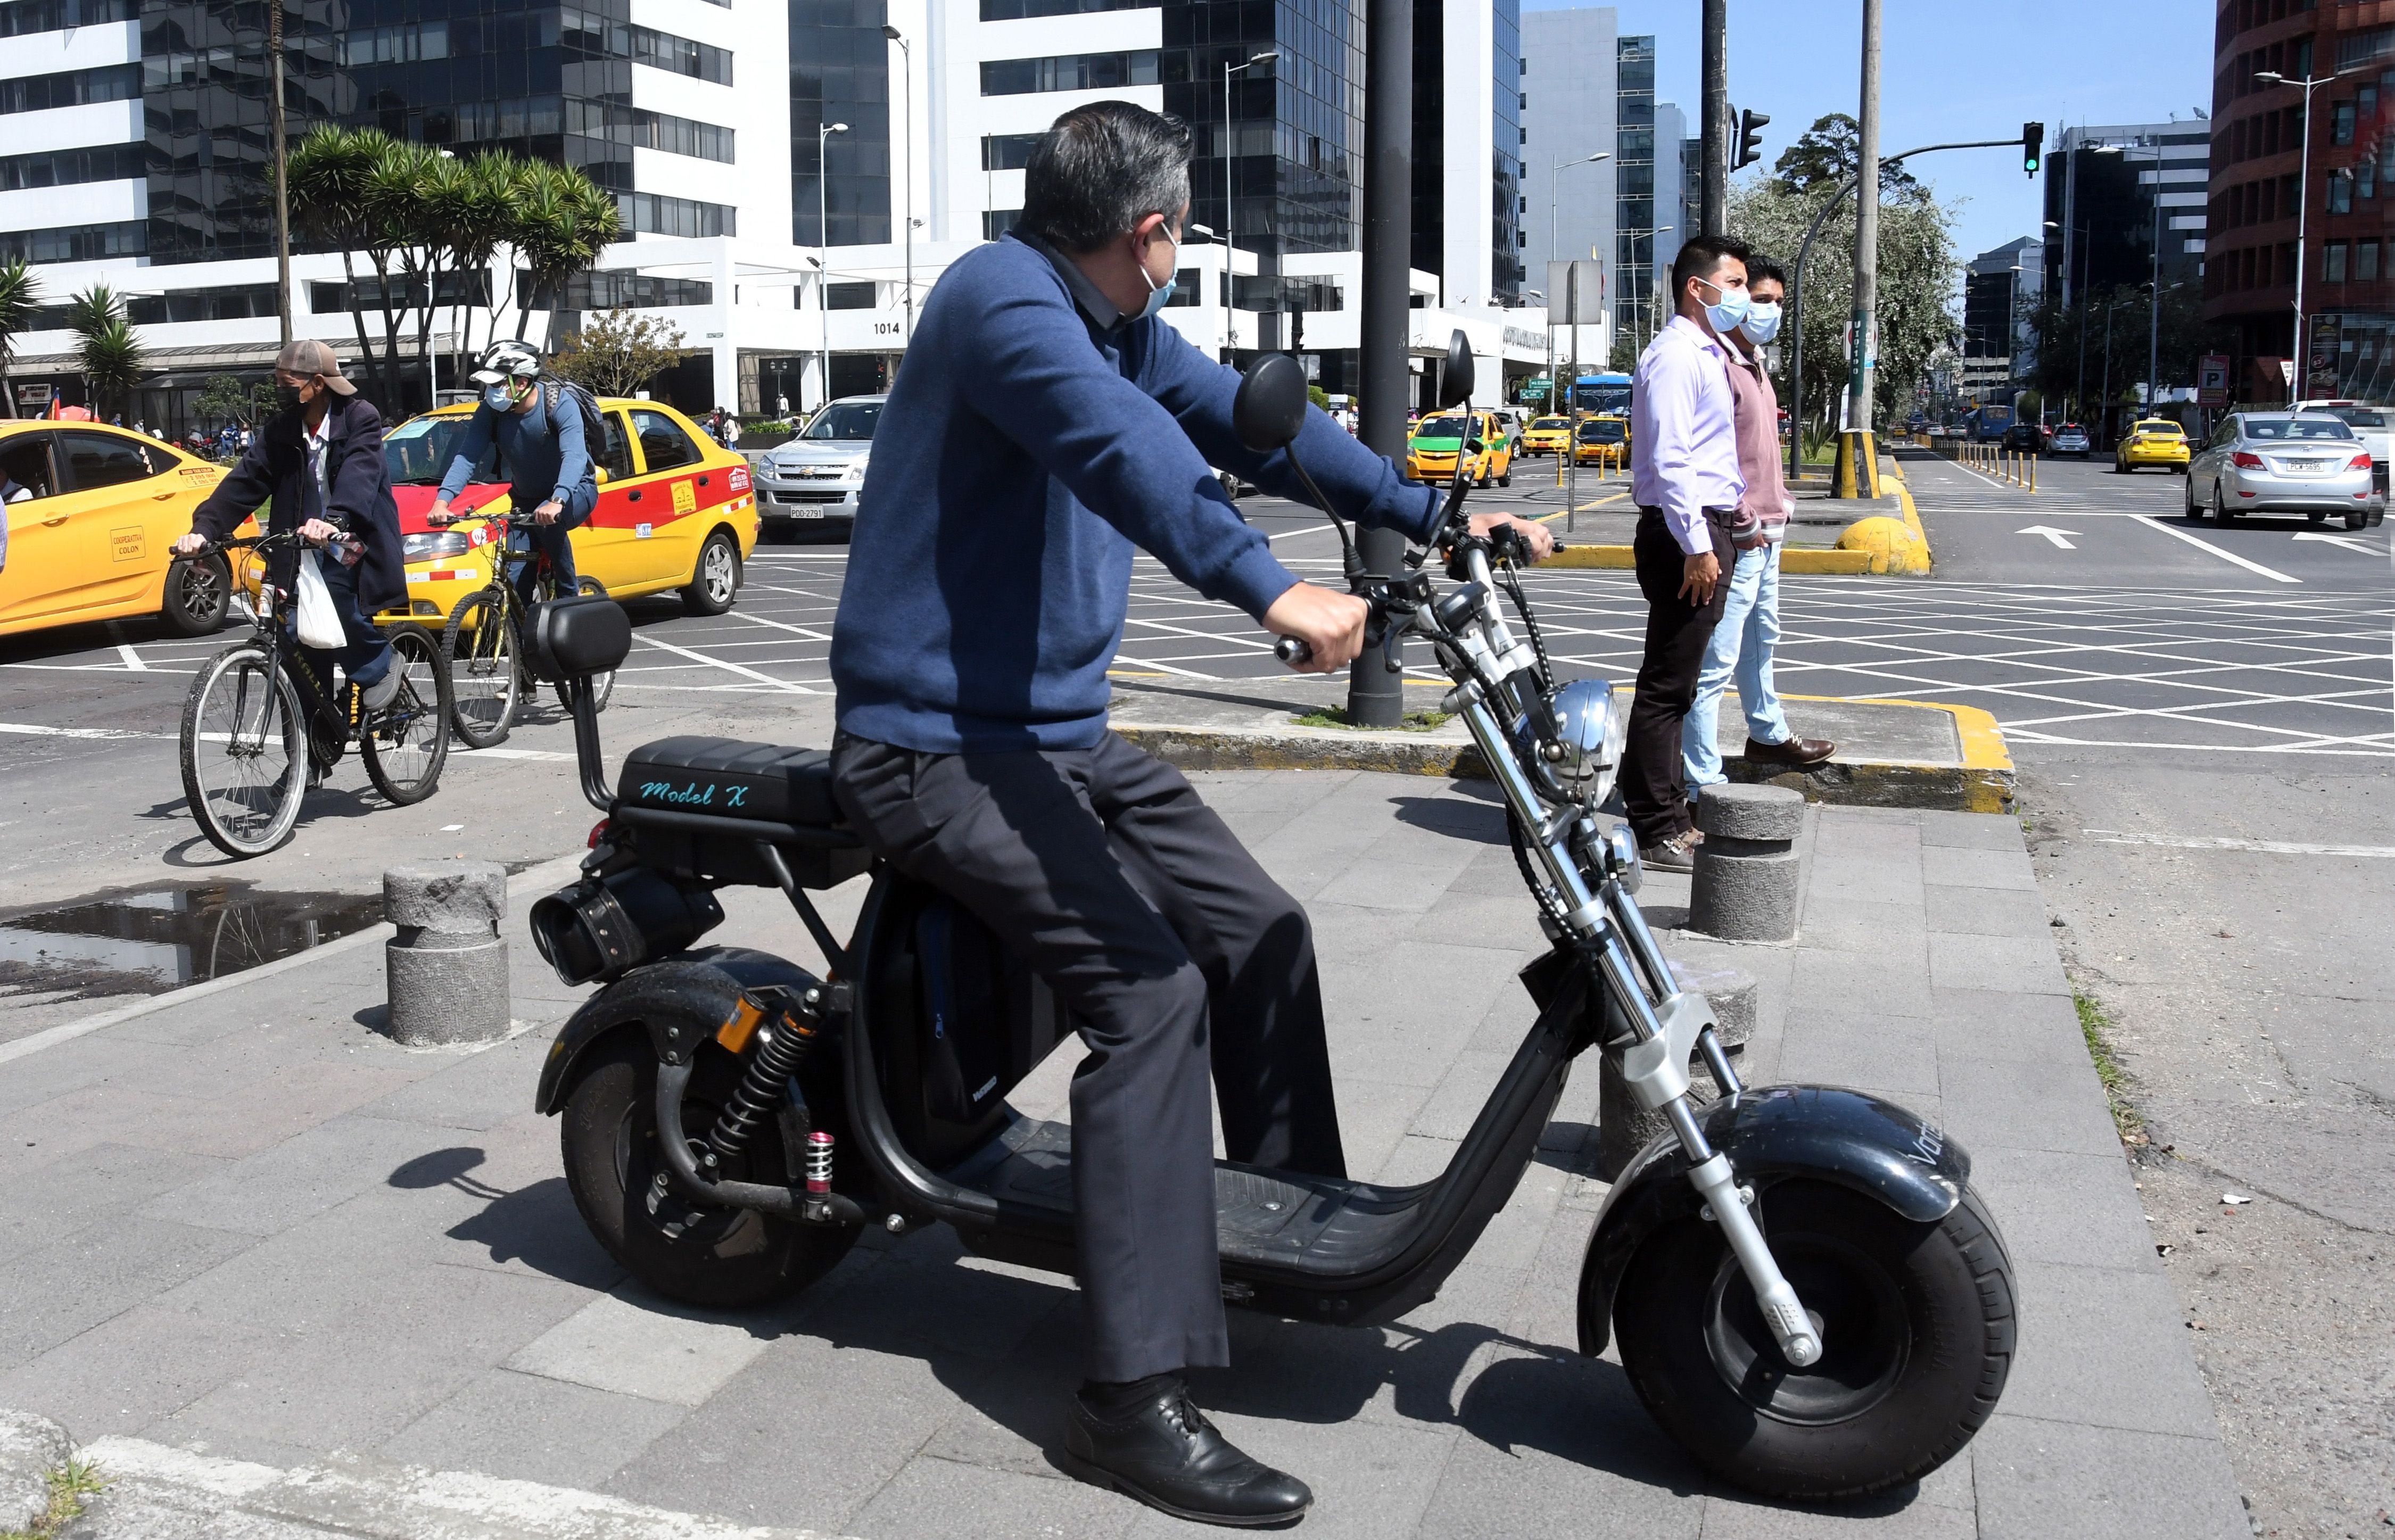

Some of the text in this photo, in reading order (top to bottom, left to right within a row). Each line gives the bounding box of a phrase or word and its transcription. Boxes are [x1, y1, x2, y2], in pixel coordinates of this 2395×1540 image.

[874, 322, 899, 334] 1014
[2206, 372, 2219, 386] P
[139, 445, 154, 475] 444
[113, 534, 142, 545] COOPERATIVA
[119, 545, 139, 554] COLON
[640, 782, 749, 807] Model X
